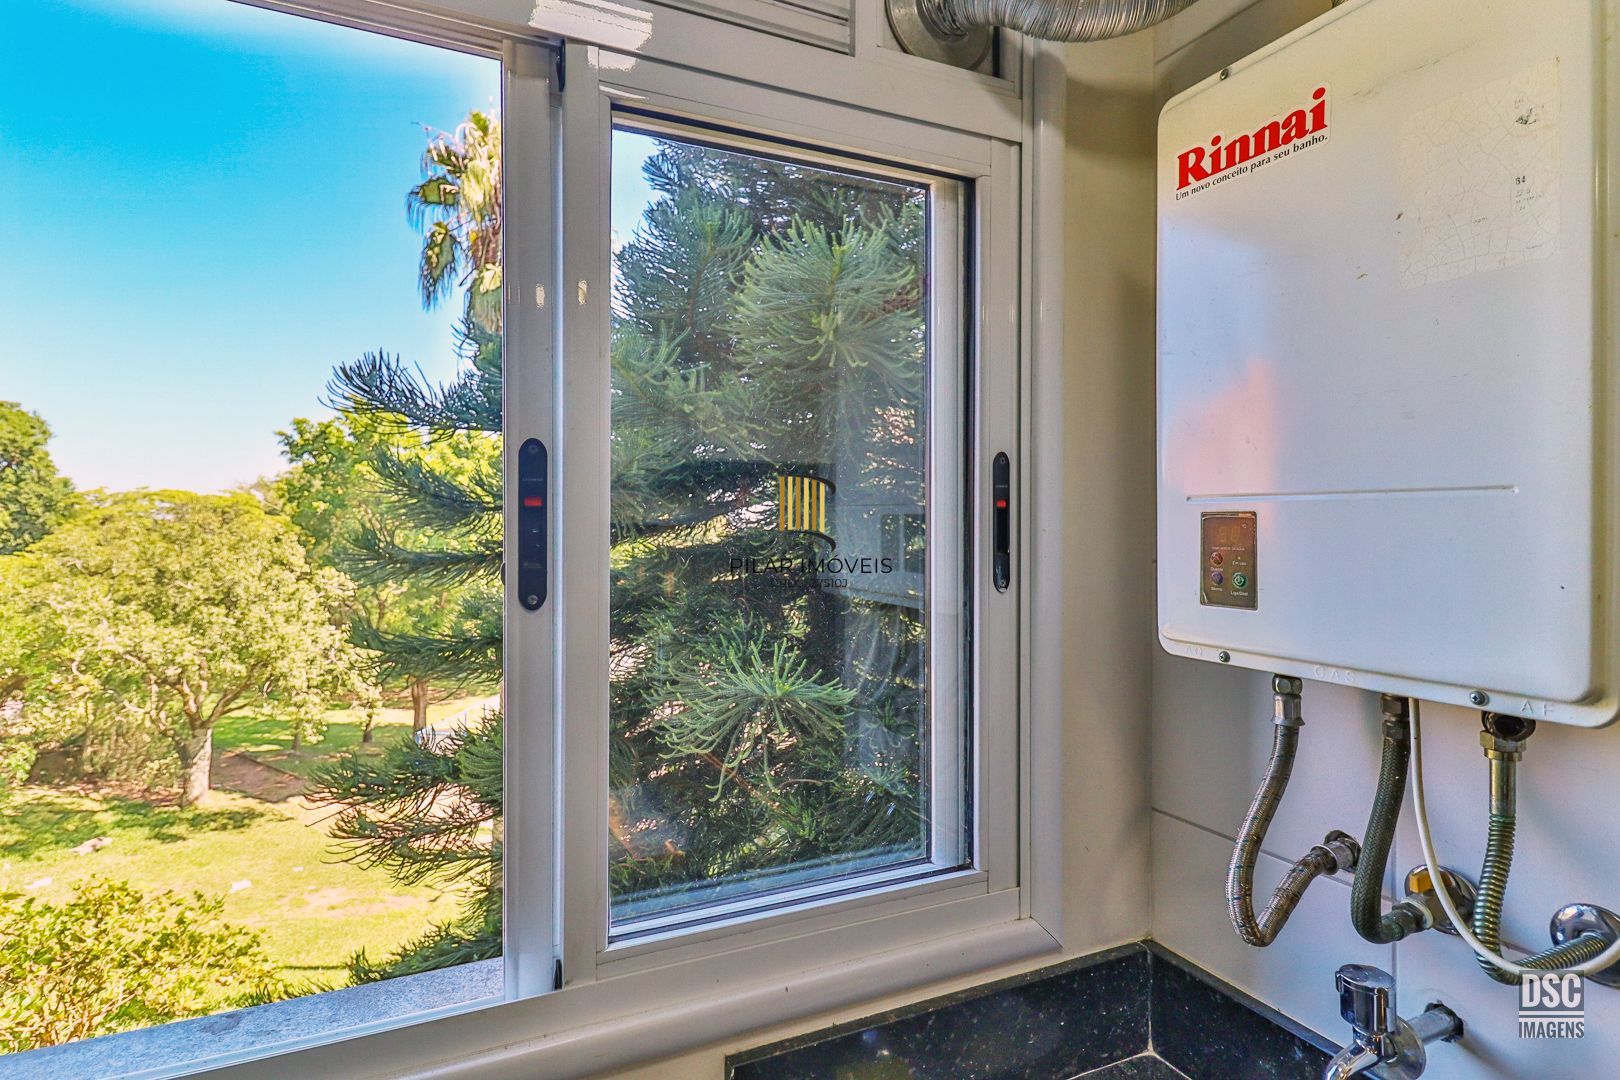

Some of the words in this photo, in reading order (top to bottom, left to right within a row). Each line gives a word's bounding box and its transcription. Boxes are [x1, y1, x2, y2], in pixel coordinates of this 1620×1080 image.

[1175, 191, 1189, 201] Um
[1191, 182, 1210, 195] novo
[1212, 166, 1249, 186] conceito
[1250, 156, 1271, 173] para
[1273, 149, 1290, 161] seu
[1293, 133, 1328, 153] banho.
[1176, 87, 1328, 190] Rinnai
